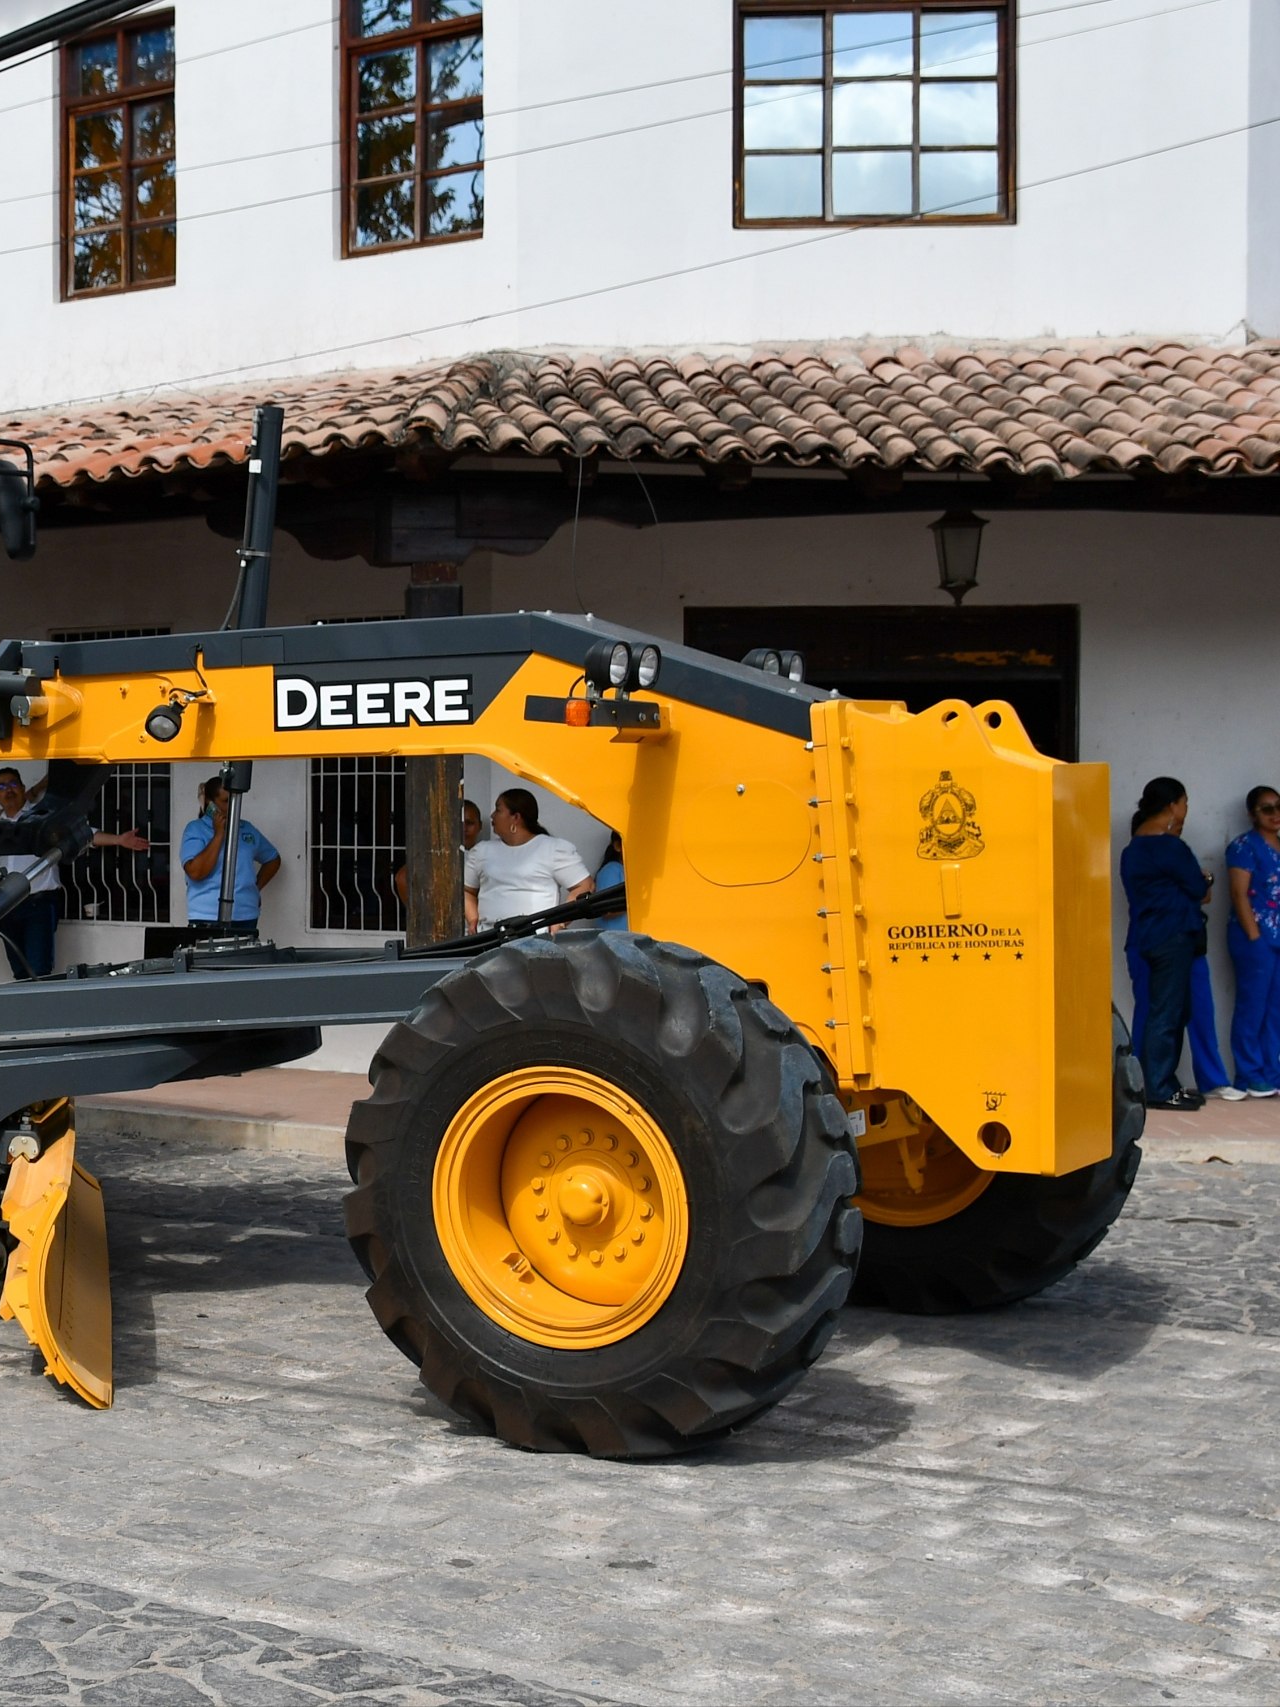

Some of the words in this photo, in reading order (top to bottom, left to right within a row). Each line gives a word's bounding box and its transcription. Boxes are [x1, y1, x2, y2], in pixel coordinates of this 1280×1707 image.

[276, 678, 470, 728] DEERE
[888, 923, 988, 939] GOBIERNO
[991, 928, 1006, 937] DE
[1008, 927, 1021, 936] LA
[948, 940, 962, 949] DE
[964, 939, 1025, 949] HONDURAS
